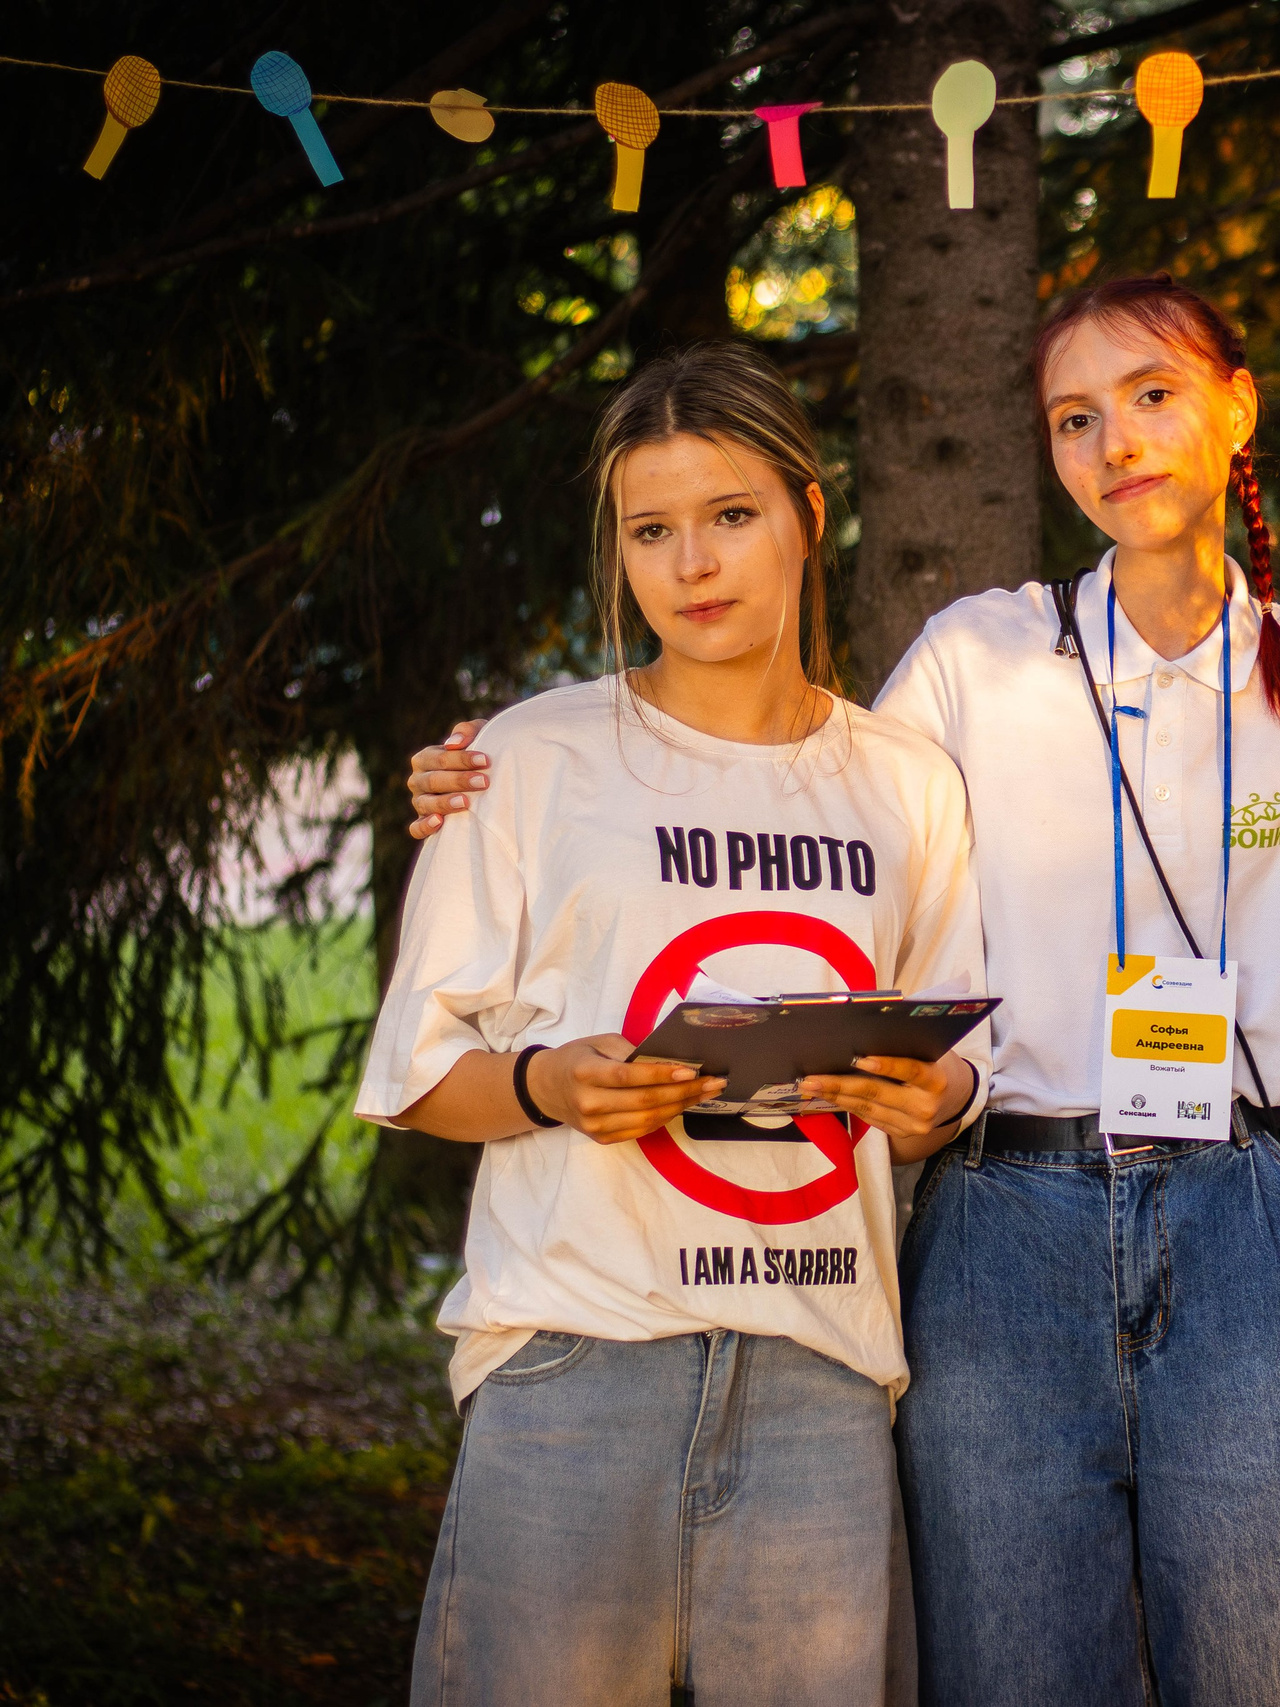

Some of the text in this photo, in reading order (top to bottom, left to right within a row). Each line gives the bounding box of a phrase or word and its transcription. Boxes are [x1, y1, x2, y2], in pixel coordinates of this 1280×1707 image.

[655, 826, 876, 897] NO PHOTO
[1150, 1024, 1189, 1036] Софья
[1135, 1038, 1204, 1051] Андреевна
[1150, 1064, 1186, 1073] Вожатый
[1118, 1109, 1157, 1118] Сенсация
[679, 1246, 858, 1286] I AM A STARRRR
